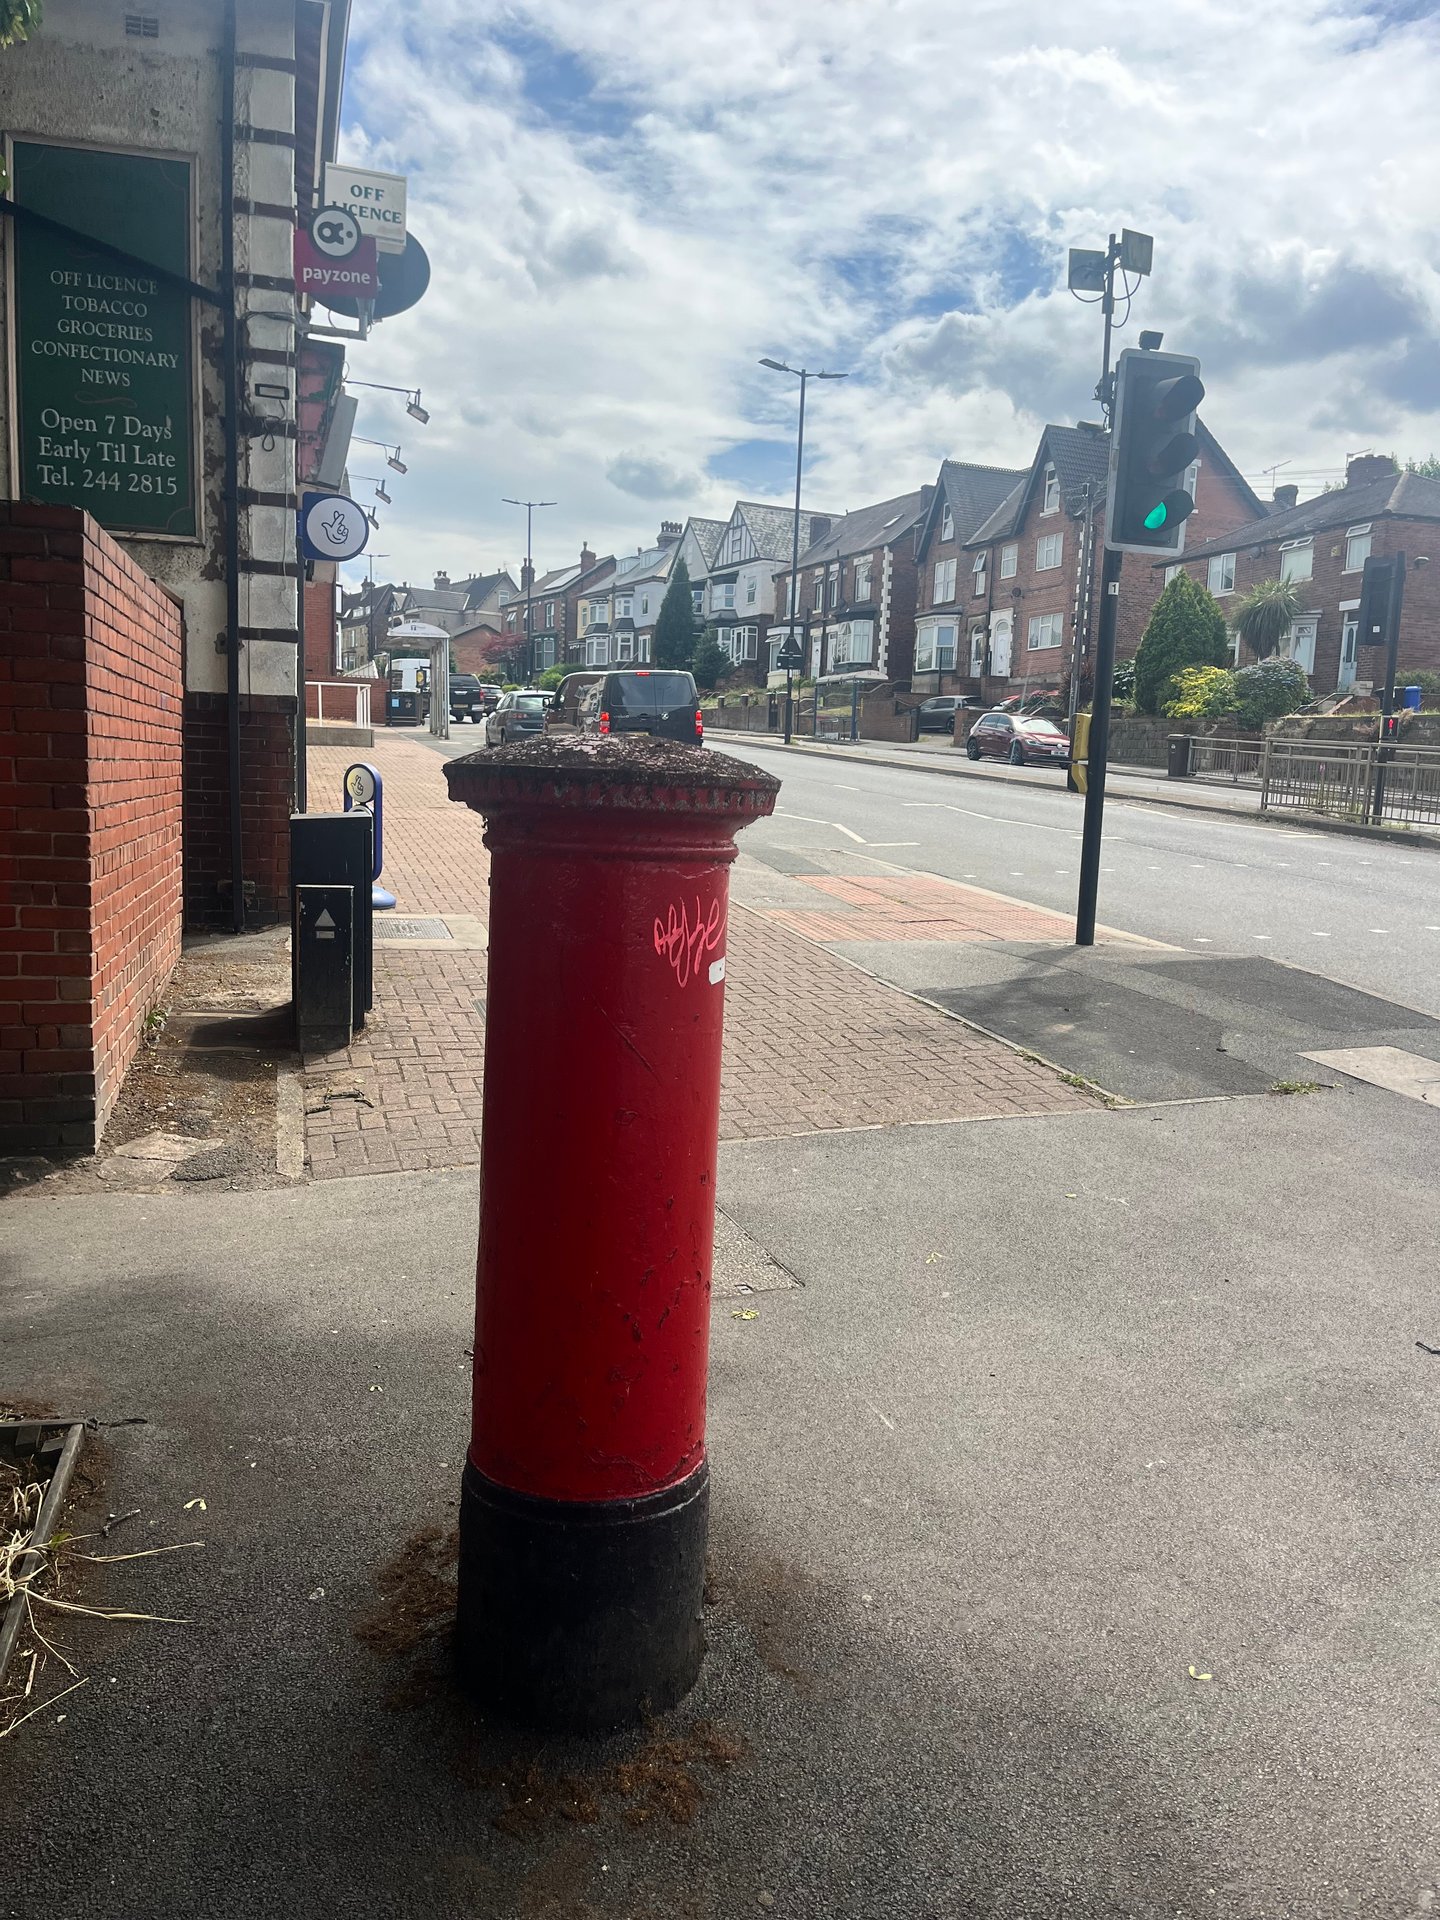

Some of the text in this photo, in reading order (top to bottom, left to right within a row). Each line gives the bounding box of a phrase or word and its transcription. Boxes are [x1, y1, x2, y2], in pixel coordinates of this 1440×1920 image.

[350, 184, 385, 201] OFF
[50, 270, 158, 295] OFF LICENCE
[303, 267, 370, 285] payzone
[62, 295, 148, 318] TOBACCO
[57, 319, 153, 342] GROCERIES
[31, 340, 179, 368] CONFECTIONARY
[81, 368, 131, 387] NEWS
[41, 408, 172, 443] Open 7 Days
[38, 436, 176, 468] Early Til Late
[37, 464, 177, 495] Tel. 244 2815
[1112, 583, 1117, 594] 1
